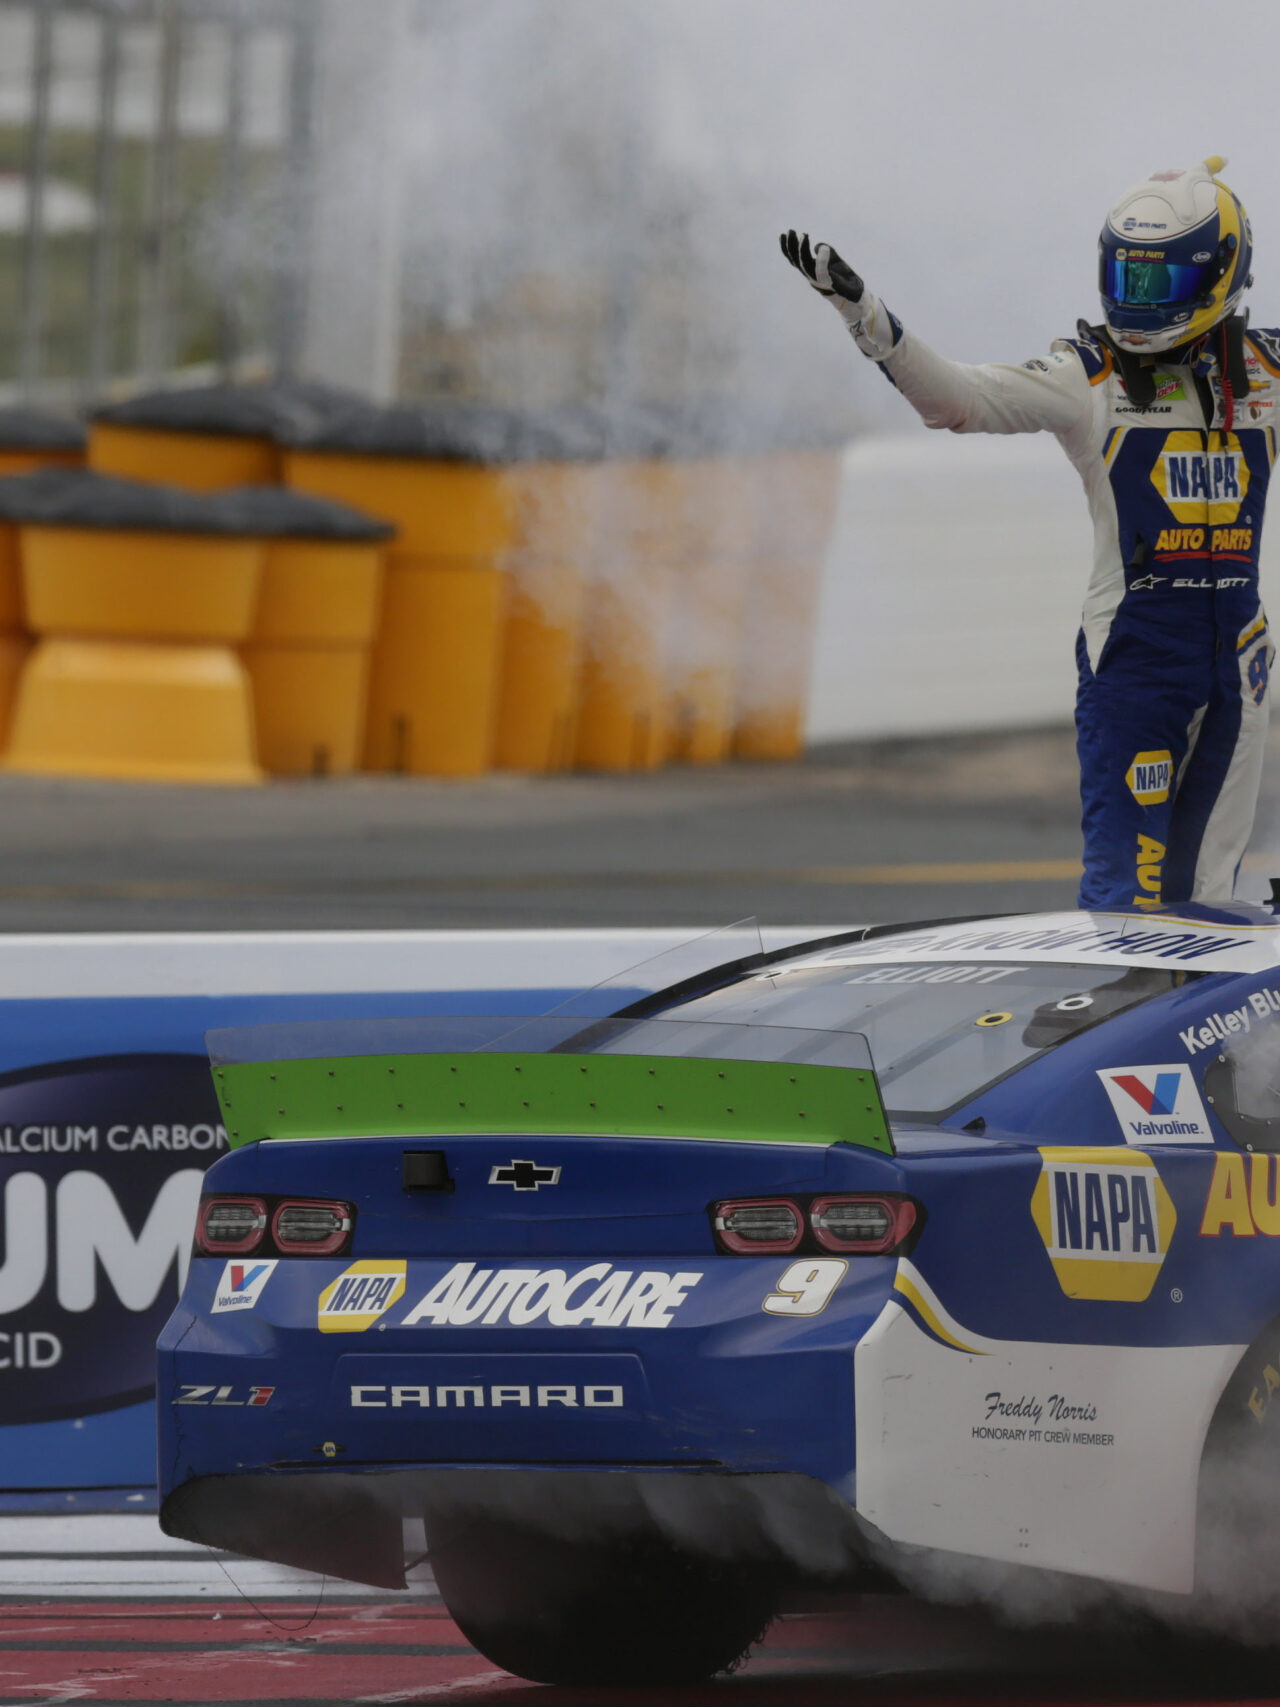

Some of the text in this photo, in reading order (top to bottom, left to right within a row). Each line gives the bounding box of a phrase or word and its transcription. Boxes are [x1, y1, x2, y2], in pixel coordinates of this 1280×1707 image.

[1168, 456, 1239, 498] NAPA
[1155, 528, 1253, 552] AUTO PARTS
[1172, 577, 1250, 590] ELLIOTT
[1135, 763, 1170, 791] NAPA
[844, 966, 1029, 985] ELLIOTT
[1179, 1005, 1250, 1055] Kelley
[0, 1126, 98, 1152] LCIUM
[1129, 1119, 1201, 1136] Valvoline
[1054, 1171, 1157, 1254] NAPA
[326, 1262, 704, 1329] NAPA AUTOCARE
[763, 1258, 849, 1316] 9
[218, 1295, 252, 1307] Valvoline
[172, 1385, 276, 1406] ZL1
[351, 1385, 624, 1408] CAMARO
[985, 1392, 1097, 1425] Freddy Norris
[972, 1426, 1115, 1446] HONORARY PIT CREW MEMBER
